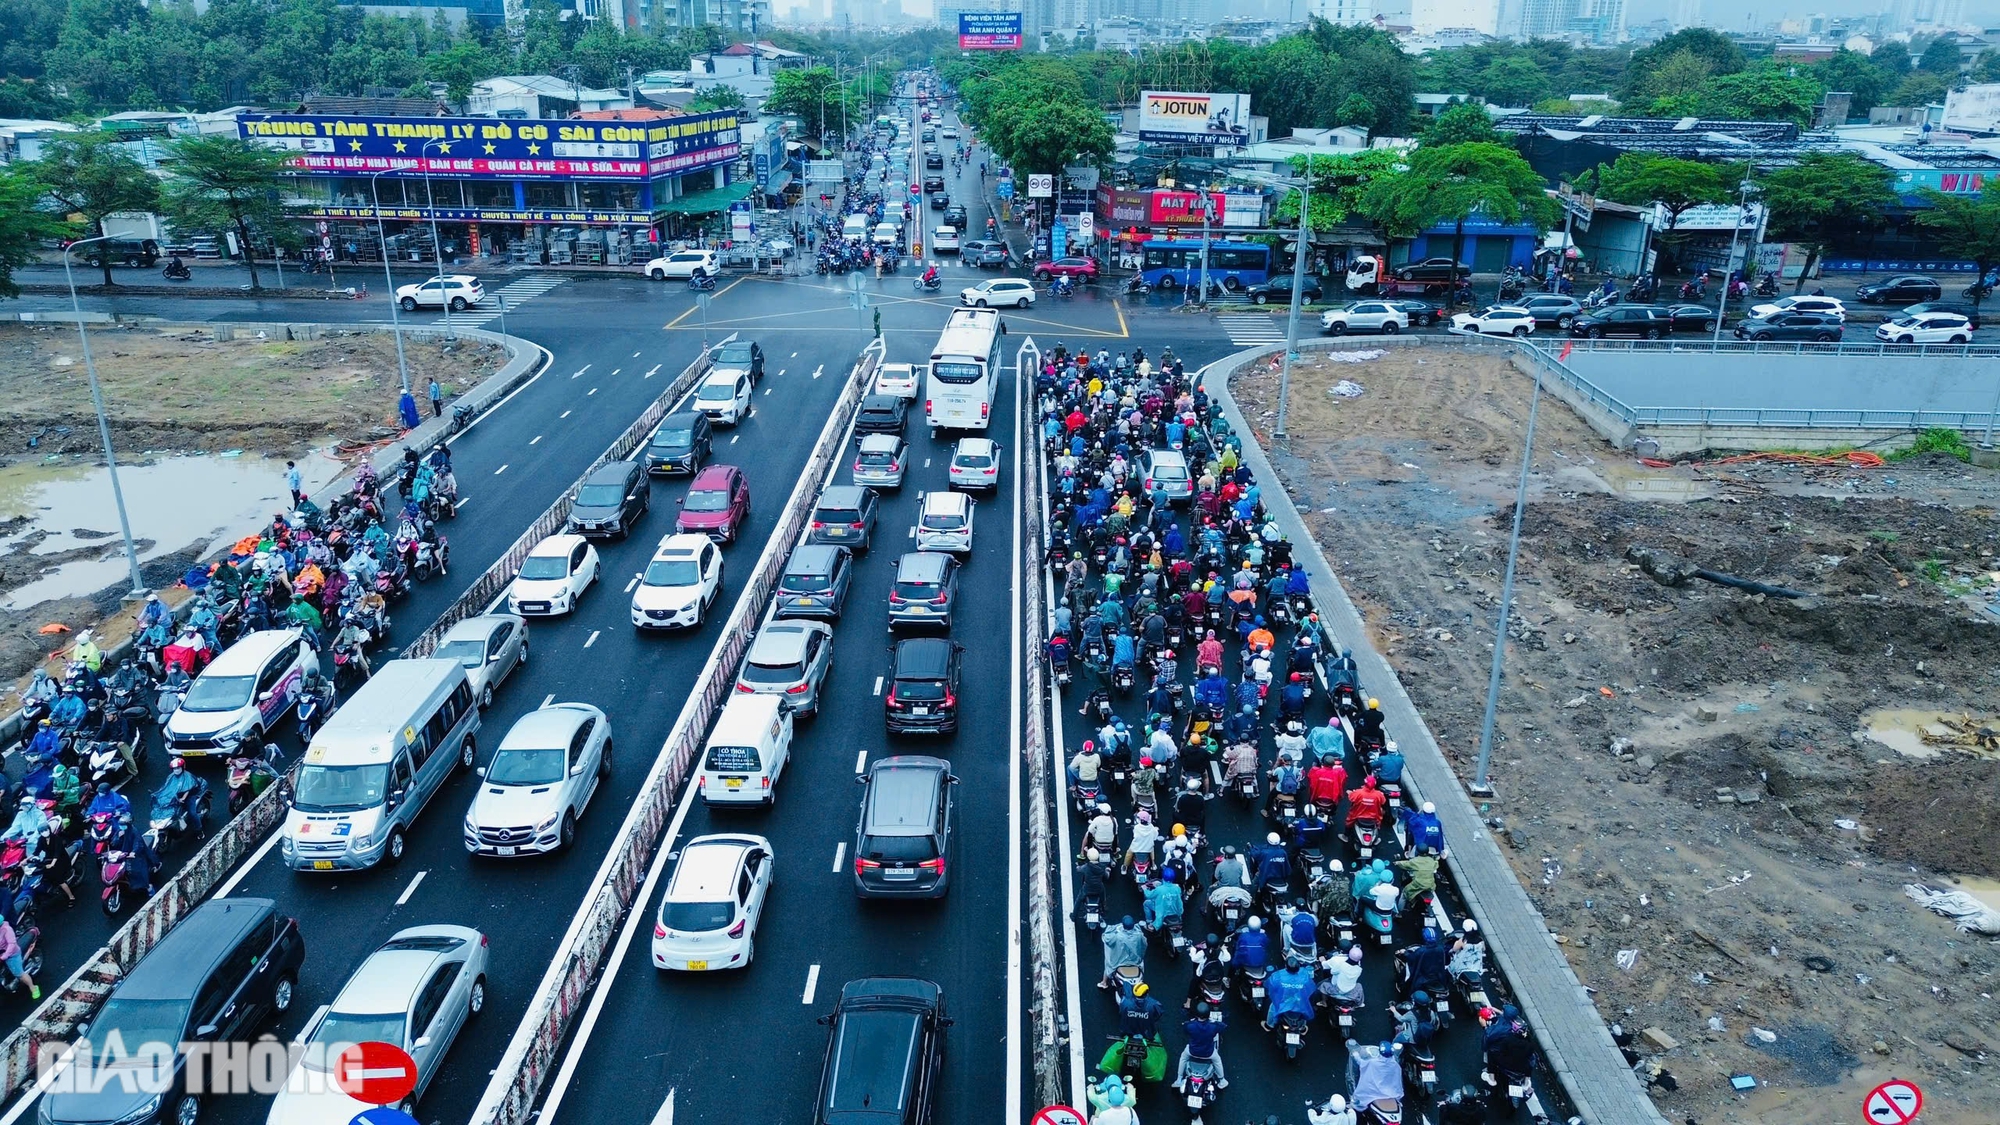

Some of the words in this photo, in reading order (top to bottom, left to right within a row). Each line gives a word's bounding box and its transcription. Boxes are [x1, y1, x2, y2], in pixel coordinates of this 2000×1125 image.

[1163, 102, 1207, 115] JOTUN
[244, 122, 316, 135] TRUNG
[321, 120, 369, 136] TÂM
[372, 123, 446, 138] THANH
[452, 123, 475, 138] LÝ
[482, 122, 512, 139] ĐỒ
[518, 124, 548, 140] CŨ
[559, 125, 595, 141] SÀI
[601, 126, 646, 142] GÒN
[1187, 134, 1202, 143] VIỆT
[1205, 135, 1217, 143] MỸ
[302, 155, 332, 167] THIẾT
[334, 157, 345, 168] BỊ
[345, 155, 366, 167] BẾP
[367, 157, 388, 168] NHÀ
[390, 158, 419, 168] HÀNG
[429, 158, 452, 169] BÀN
[453, 158, 474, 170] GHẾ
[488, 160, 517, 171] QUÁN
[519, 161, 535, 171] CÀ
[536, 160, 556, 171] PHÊ
[569, 161, 590, 172] TRÀ
[398, 209, 420, 217] CHIẾN
